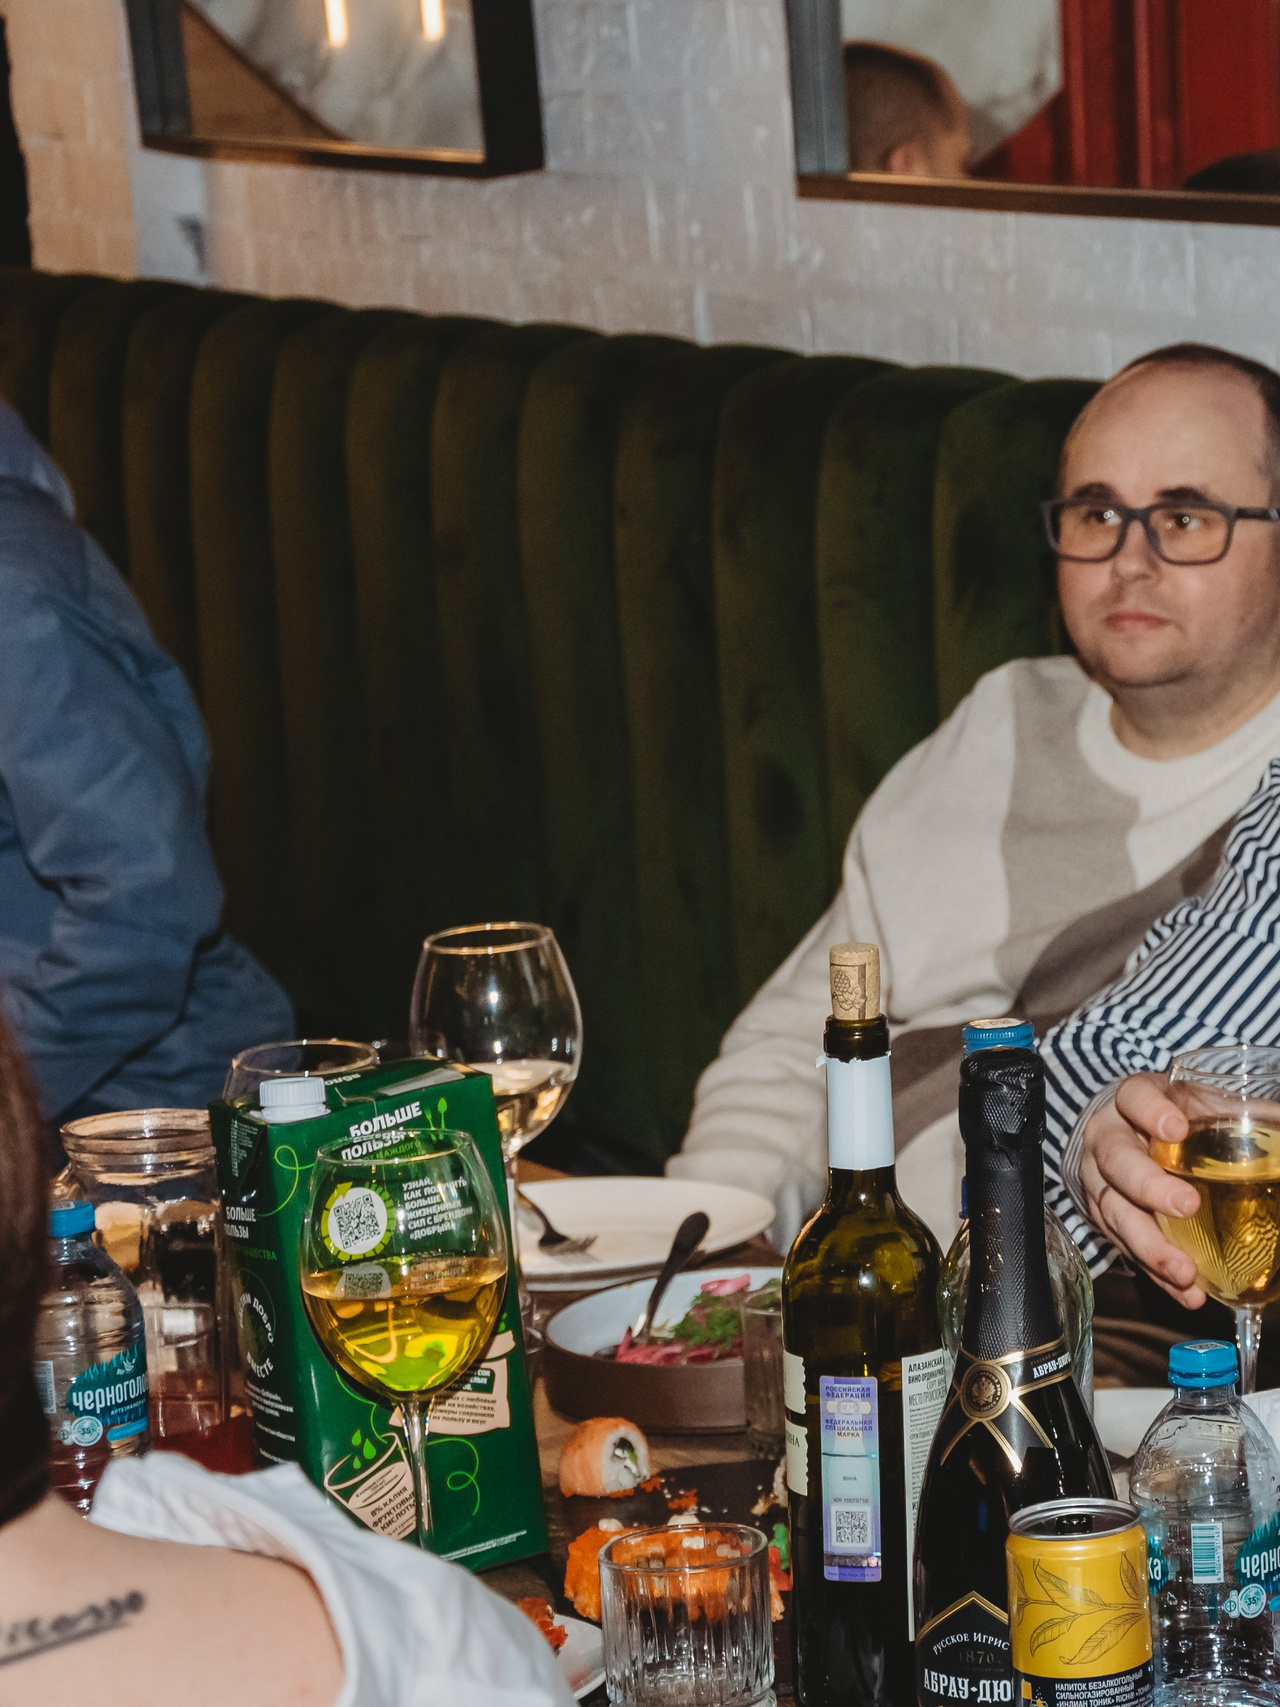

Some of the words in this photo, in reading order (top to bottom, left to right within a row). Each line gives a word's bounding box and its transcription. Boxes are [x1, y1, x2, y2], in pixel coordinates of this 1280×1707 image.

[349, 1101, 423, 1138] БОЛЬШЕ
[403, 1189, 422, 1201] КАК
[405, 1196, 444, 1210] БОЛЬШЕ
[226, 1206, 256, 1222] БОЛЬШЕ
[408, 1217, 426, 1230] СИЛ
[932, 1633, 970, 1655] РУССКОЕ
[1055, 1682, 1087, 1691] НАПИТОК
[1088, 1669, 1143, 1690] БЕЗАЛКОГОЛЬНЫЙ
[1055, 1681, 1135, 1700] СИЛЬНОГАЗИРОВАННЫЙ
